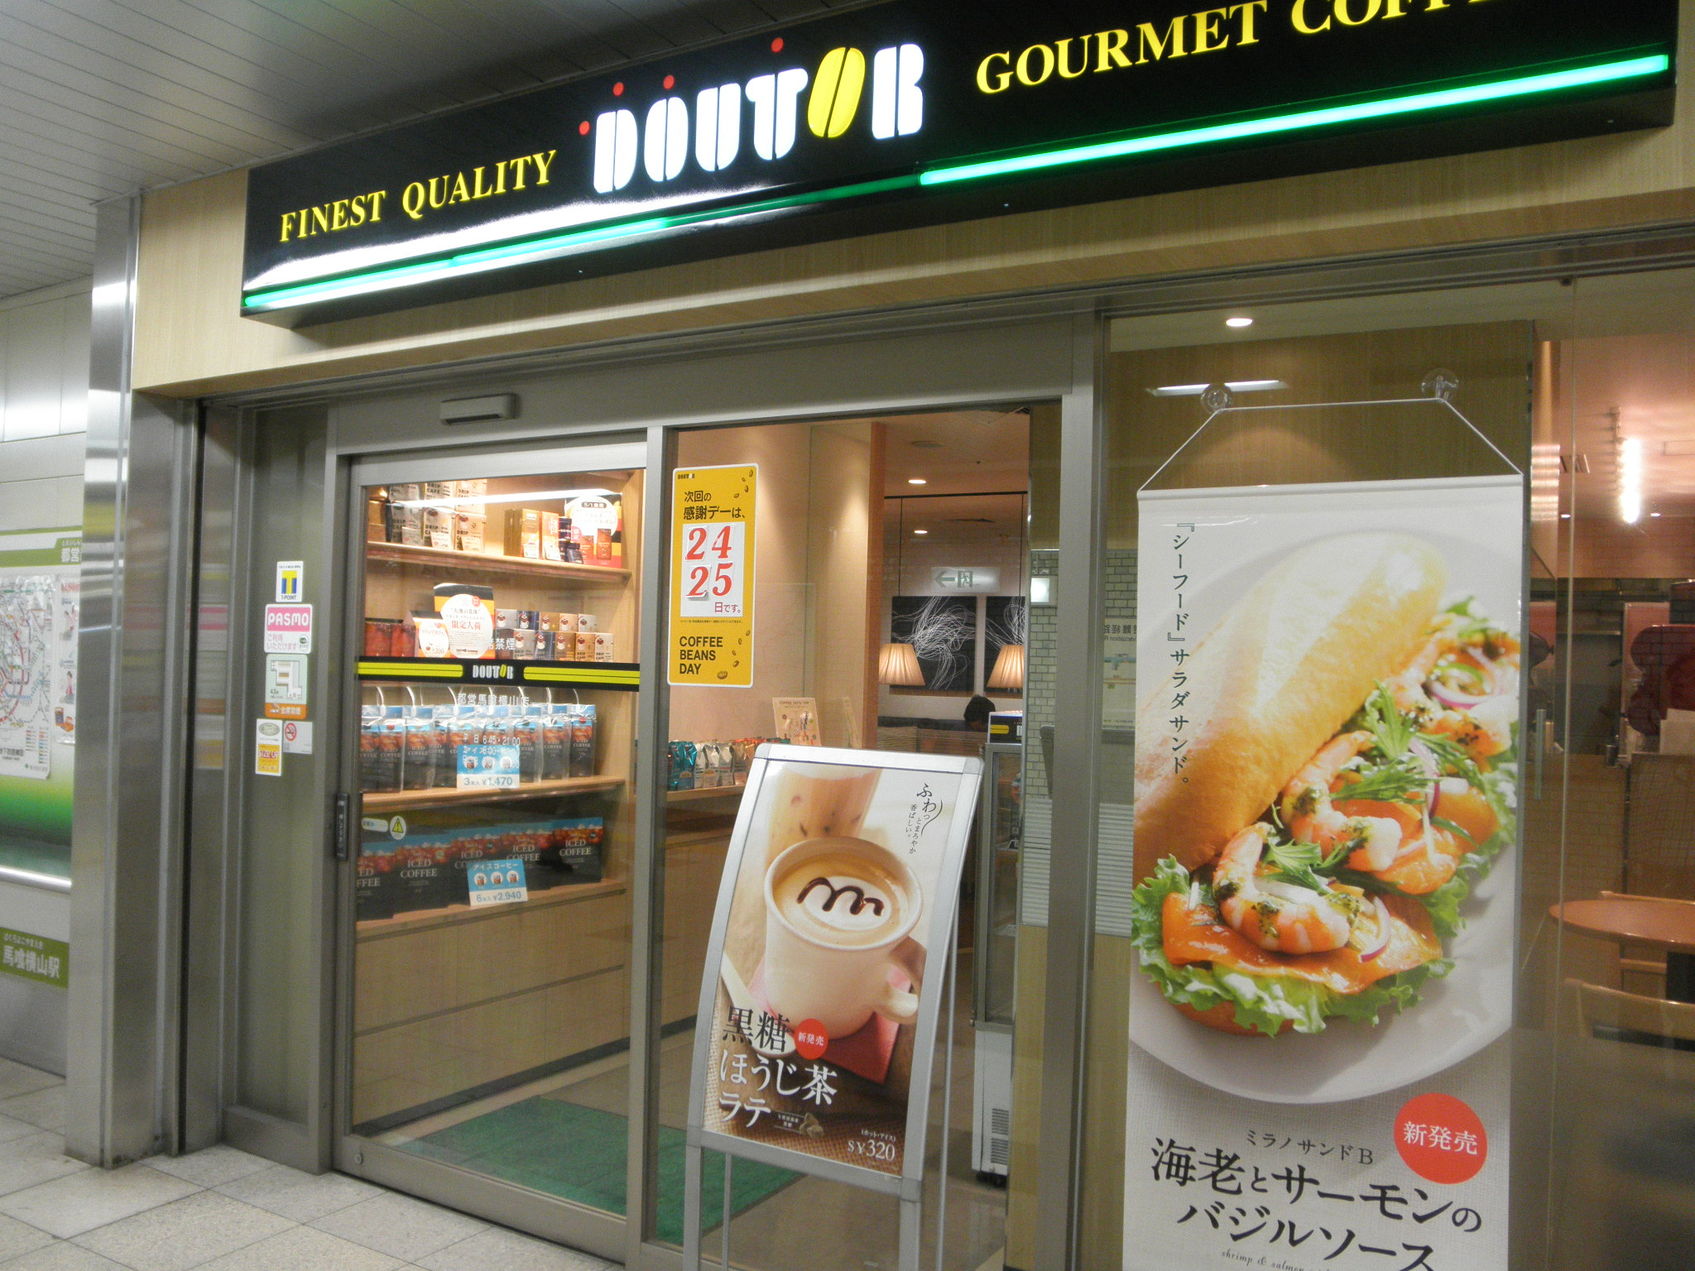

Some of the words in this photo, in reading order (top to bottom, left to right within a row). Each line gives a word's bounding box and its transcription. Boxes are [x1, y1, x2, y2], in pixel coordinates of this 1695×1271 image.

[976, 0, 1268, 94] GOURMET
[592, 43, 925, 194] DOUTOR
[279, 190, 387, 242] FINEST
[402, 150, 557, 220] QUALITY
[684, 490, 712, 503] 次回の
[683, 505, 746, 521] 感謝デーは、
[685, 525, 732, 561] 24
[686, 562, 733, 597] 25
[714, 601, 742, 614] 日です。
[267, 612, 309, 627] PASMO
[679, 636, 724, 648] COFFEE
[679, 649, 717, 661] BEANS
[1167, 522, 1196, 784] 『シーフード』サラダサンド。
[472, 664, 514, 680] DOUTOR
[679, 663, 702, 675] DAY
[559, 847, 592, 857] COFFEE
[407, 859, 432, 868] ICED
[400, 868, 438, 879] COFFEE
[722, 1006, 793, 1053] 黒糖
[798, 1031, 825, 1047] 新発売
[720, 1048, 838, 1105] ほうじ茶
[719, 1091, 772, 1128] ラテ
[1403, 1121, 1479, 1156] 新発売
[1150, 1137, 1483, 1233] 海老とサーモンの
[1176, 1200, 1435, 1271] バジルソース
[1221, 1248, 1253, 1266] shrimp
